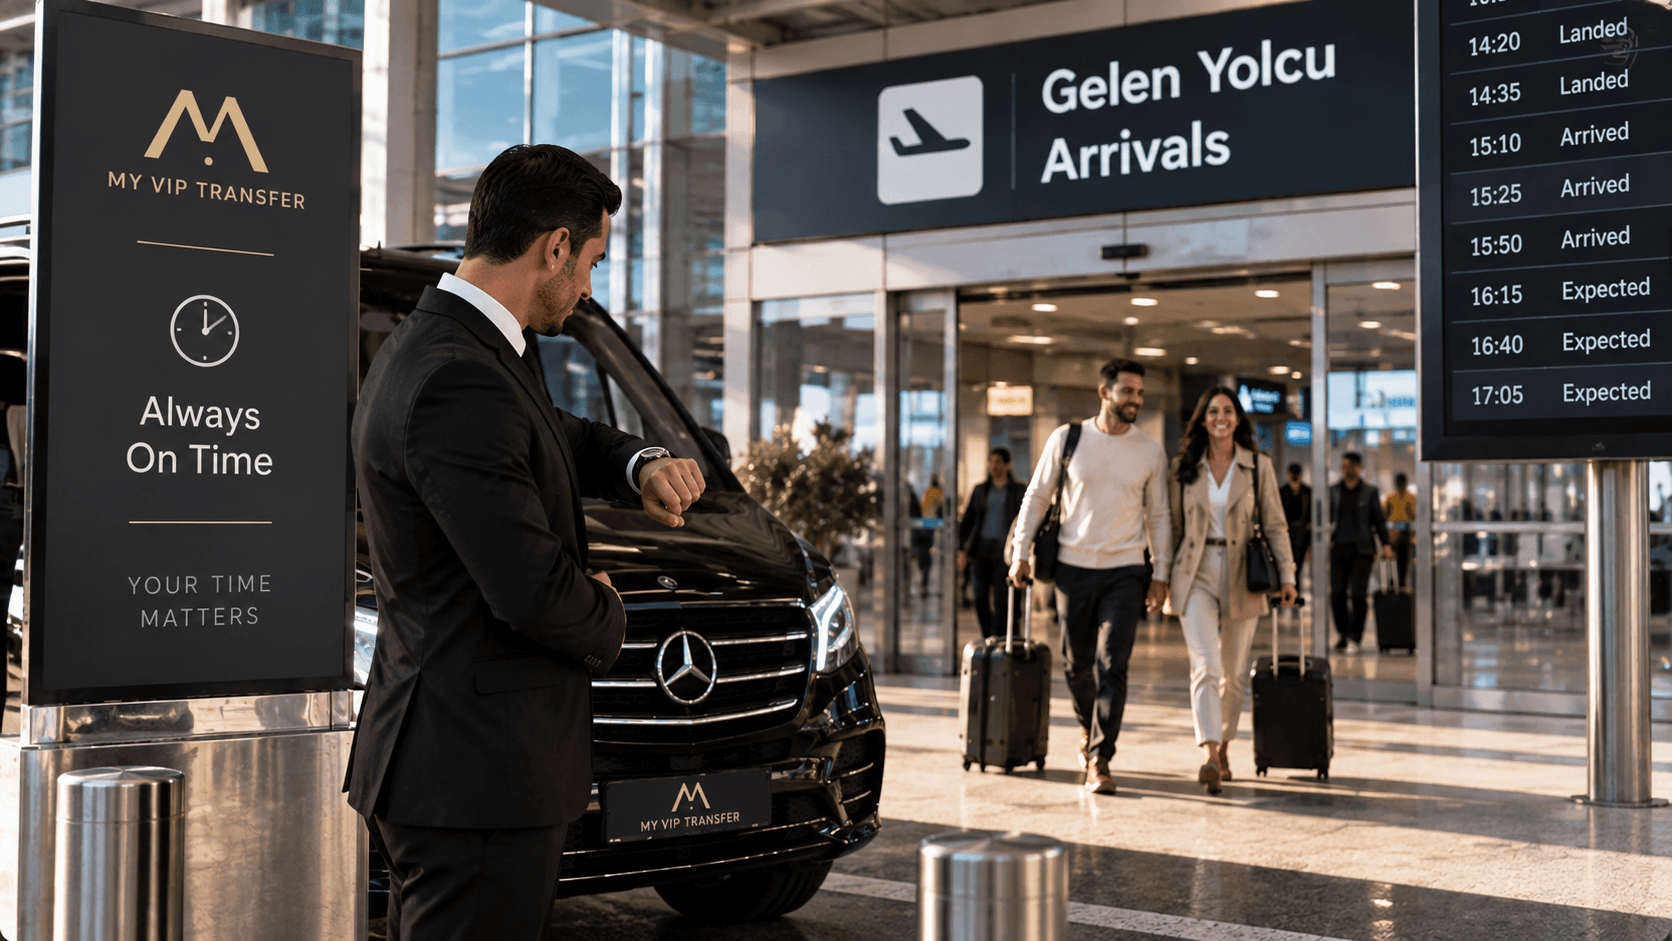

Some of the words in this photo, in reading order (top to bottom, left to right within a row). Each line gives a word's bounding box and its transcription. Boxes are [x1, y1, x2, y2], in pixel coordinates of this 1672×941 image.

[1559, 16, 1628, 44] Landed
[1468, 31, 1521, 56] 14:20
[1041, 60, 1181, 114] Gelen
[1197, 39, 1336, 93] Yolcu
[1560, 68, 1629, 95] Landed
[1469, 82, 1521, 106] 14:35
[1469, 132, 1522, 157] 15:10
[1560, 120, 1629, 147] Arrived
[1040, 119, 1231, 184] Arrivals
[108, 170, 143, 191] MY
[151, 175, 188, 196] VIP
[196, 181, 306, 210] TRANSFER
[1470, 183, 1522, 207] 15:25
[1560, 172, 1630, 198] Arrived
[1470, 233, 1523, 257] 15:50
[1560, 224, 1630, 249] Arrived
[1471, 284, 1523, 306] 16:15
[1562, 275, 1651, 304] Expected
[1471, 334, 1524, 356] 16:40
[1562, 328, 1651, 355] Expected
[1471, 384, 1524, 406] 17:05
[1563, 379, 1651, 407] Expected
[139, 395, 260, 437] Always
[126, 441, 177, 474] On
[188, 444, 273, 476] Time
[127, 575, 198, 595] YOUR
[211, 574, 271, 593] TIME
[141, 606, 258, 628] MATTERS
[640, 819, 658, 832] MY
[661, 817, 681, 830] VIP
[684, 811, 740, 827] TRANSFER
